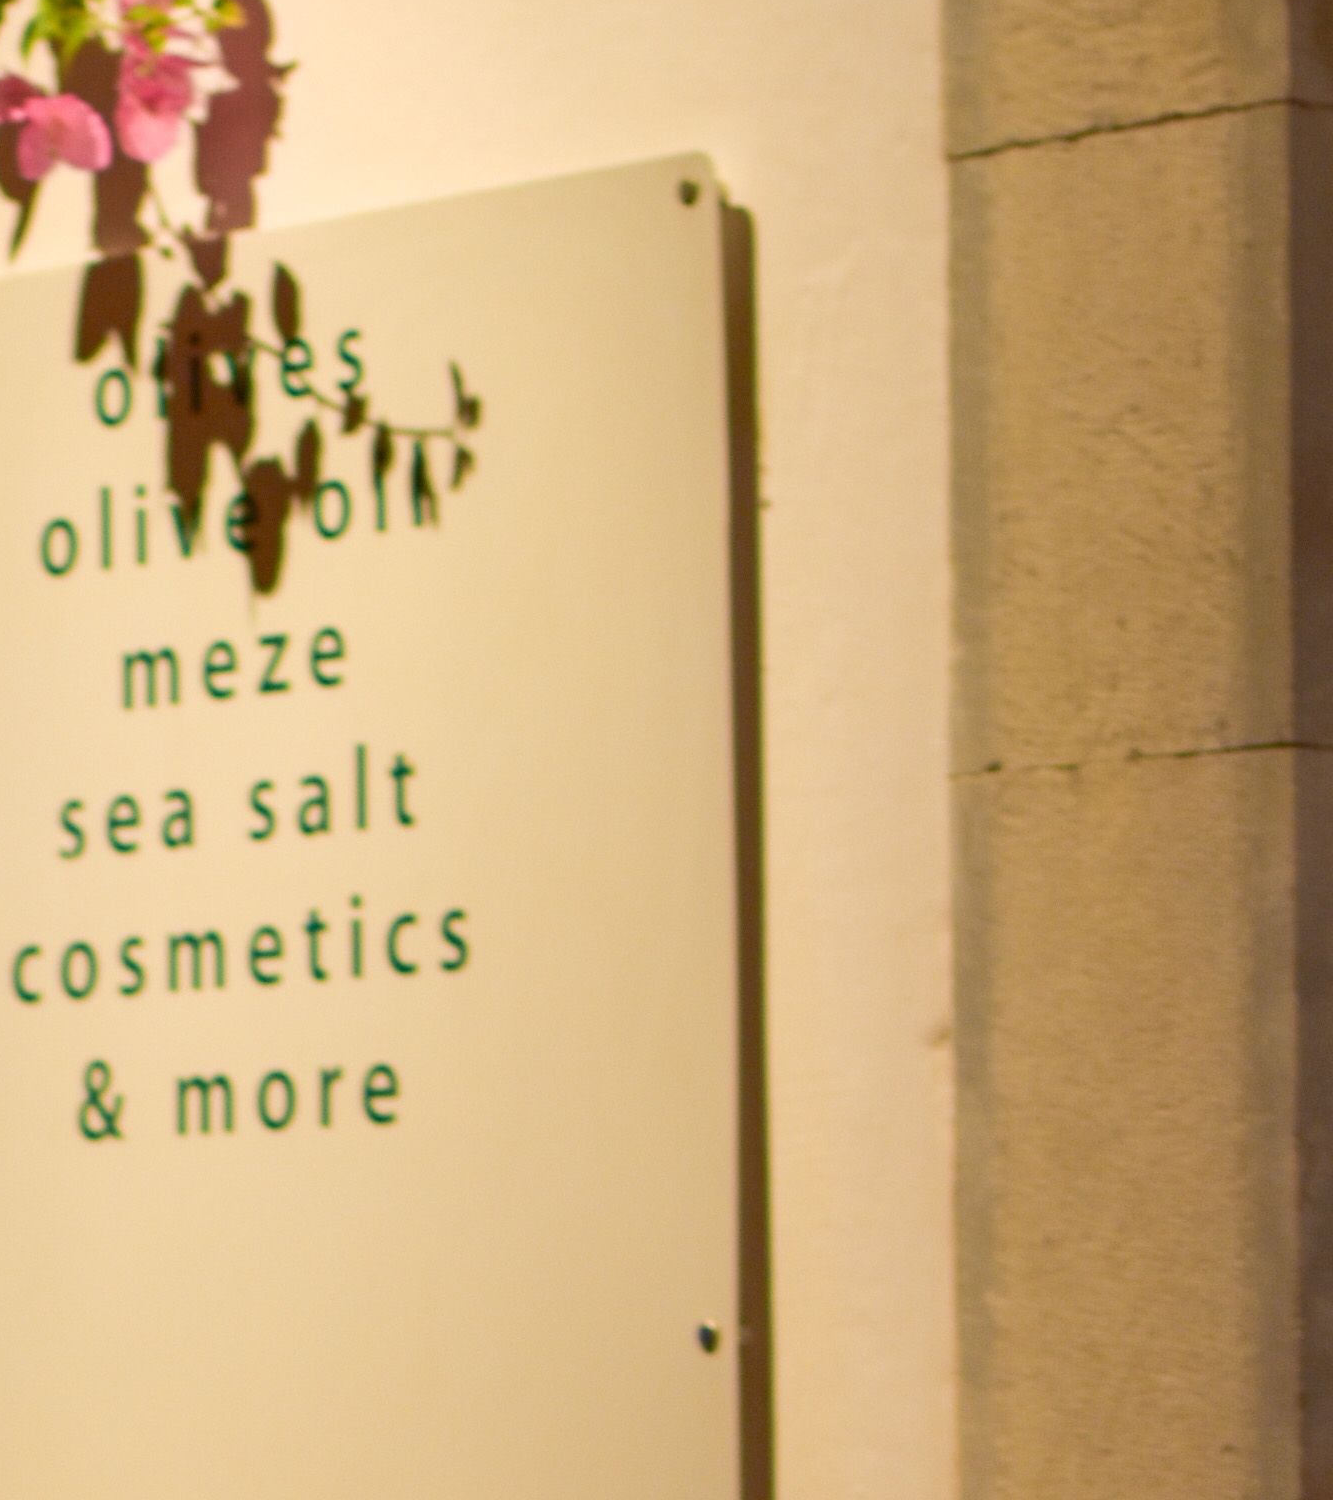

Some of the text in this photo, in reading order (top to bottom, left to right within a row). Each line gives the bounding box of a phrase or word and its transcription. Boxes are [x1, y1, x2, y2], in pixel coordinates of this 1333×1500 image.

[39, 482, 261, 577] olive
[121, 626, 348, 709] meze
[57, 743, 418, 860] sea salt
[10, 895, 471, 1005] cosmetics
[77, 1060, 402, 1142] & more
